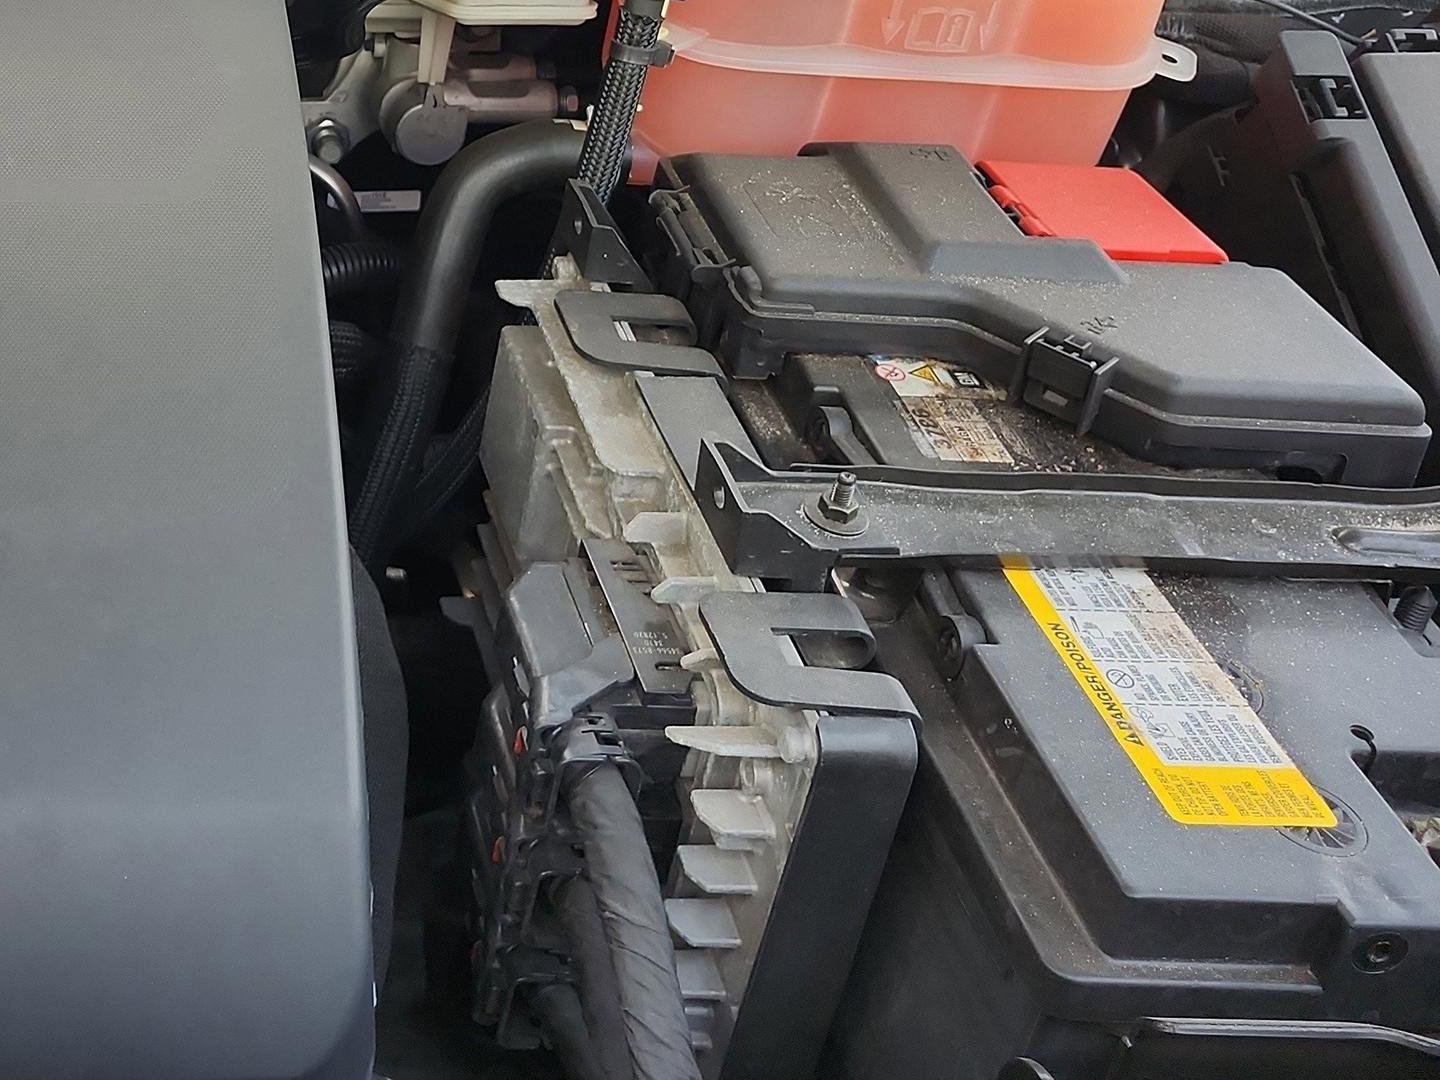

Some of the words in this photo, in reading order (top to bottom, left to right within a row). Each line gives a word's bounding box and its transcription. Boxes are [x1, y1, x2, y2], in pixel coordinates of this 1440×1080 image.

[912, 408, 952, 450] 3786
[1047, 622, 1133, 729] DANGER/POISON
[1155, 741, 1178, 760] SHIELD
[1173, 747, 1191, 760] EYES
